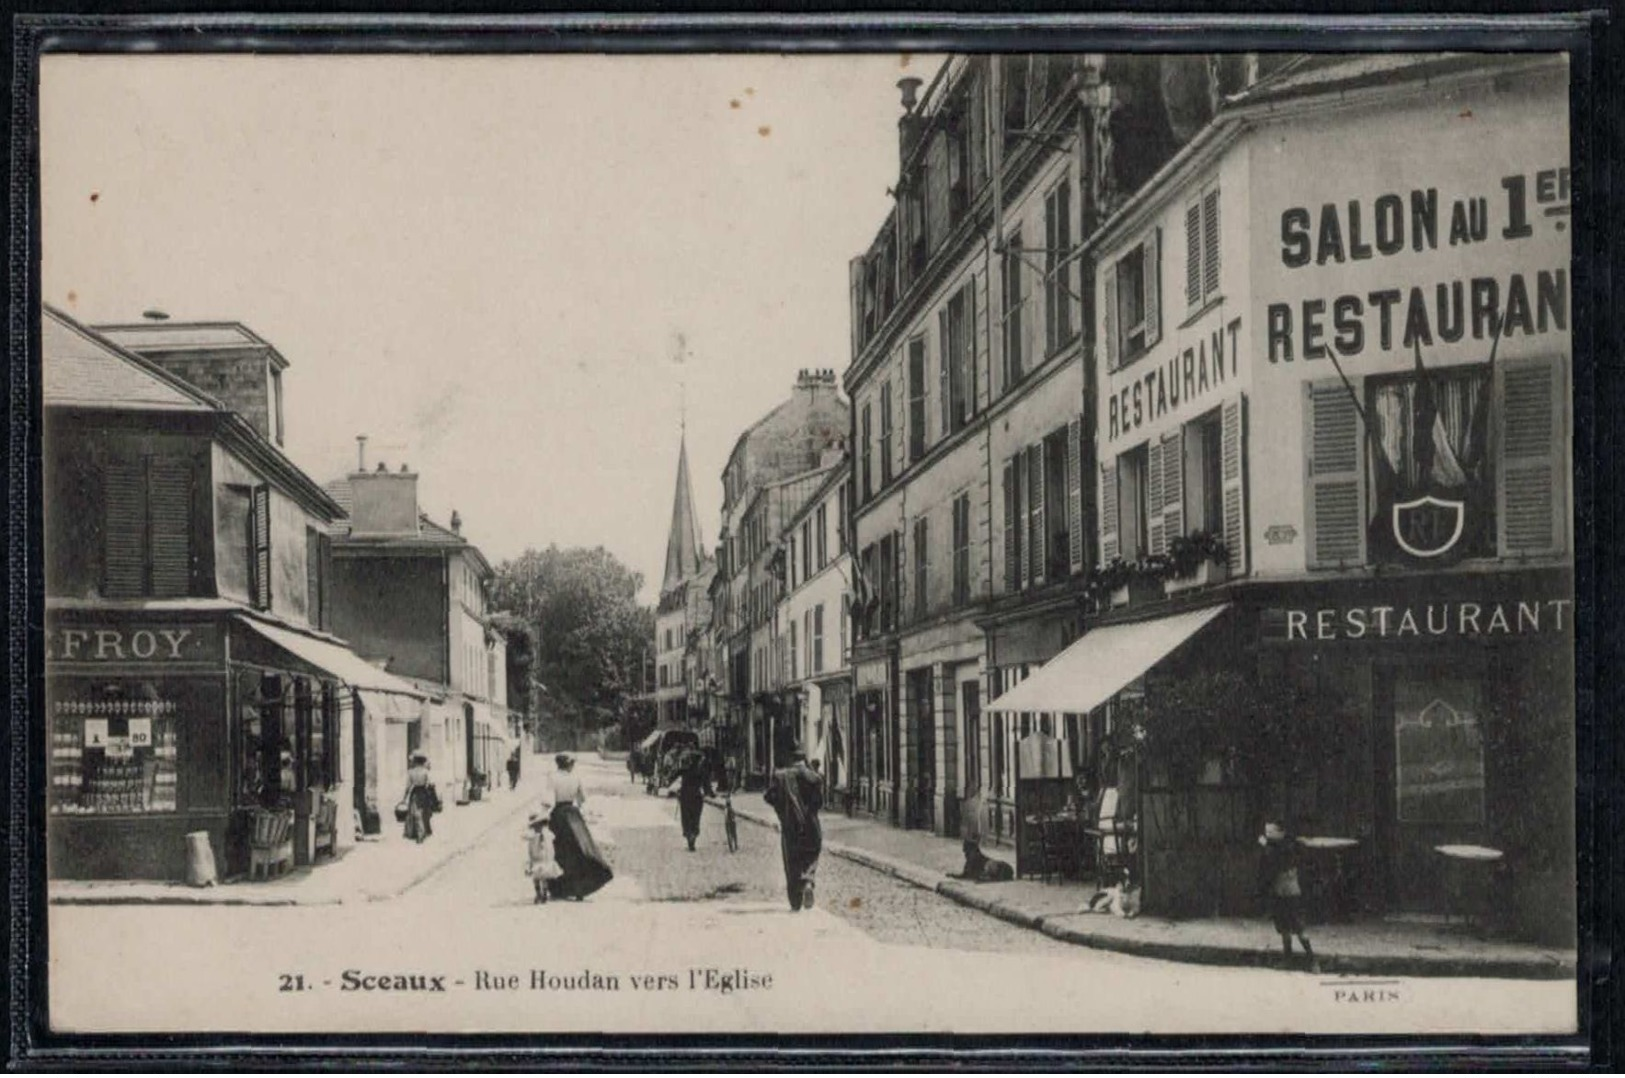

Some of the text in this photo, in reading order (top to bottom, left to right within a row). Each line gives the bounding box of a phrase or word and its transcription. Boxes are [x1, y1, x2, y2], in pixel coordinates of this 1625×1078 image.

[1280, 187, 1439, 269] SALON
[1449, 196, 1489, 246] AU
[1267, 268, 1567, 364] RESTAURAN
[1108, 316, 1242, 443] RESTAURANT
[46, 628, 192, 660] FROY
[1286, 600, 1572, 641] RESTAURANT
